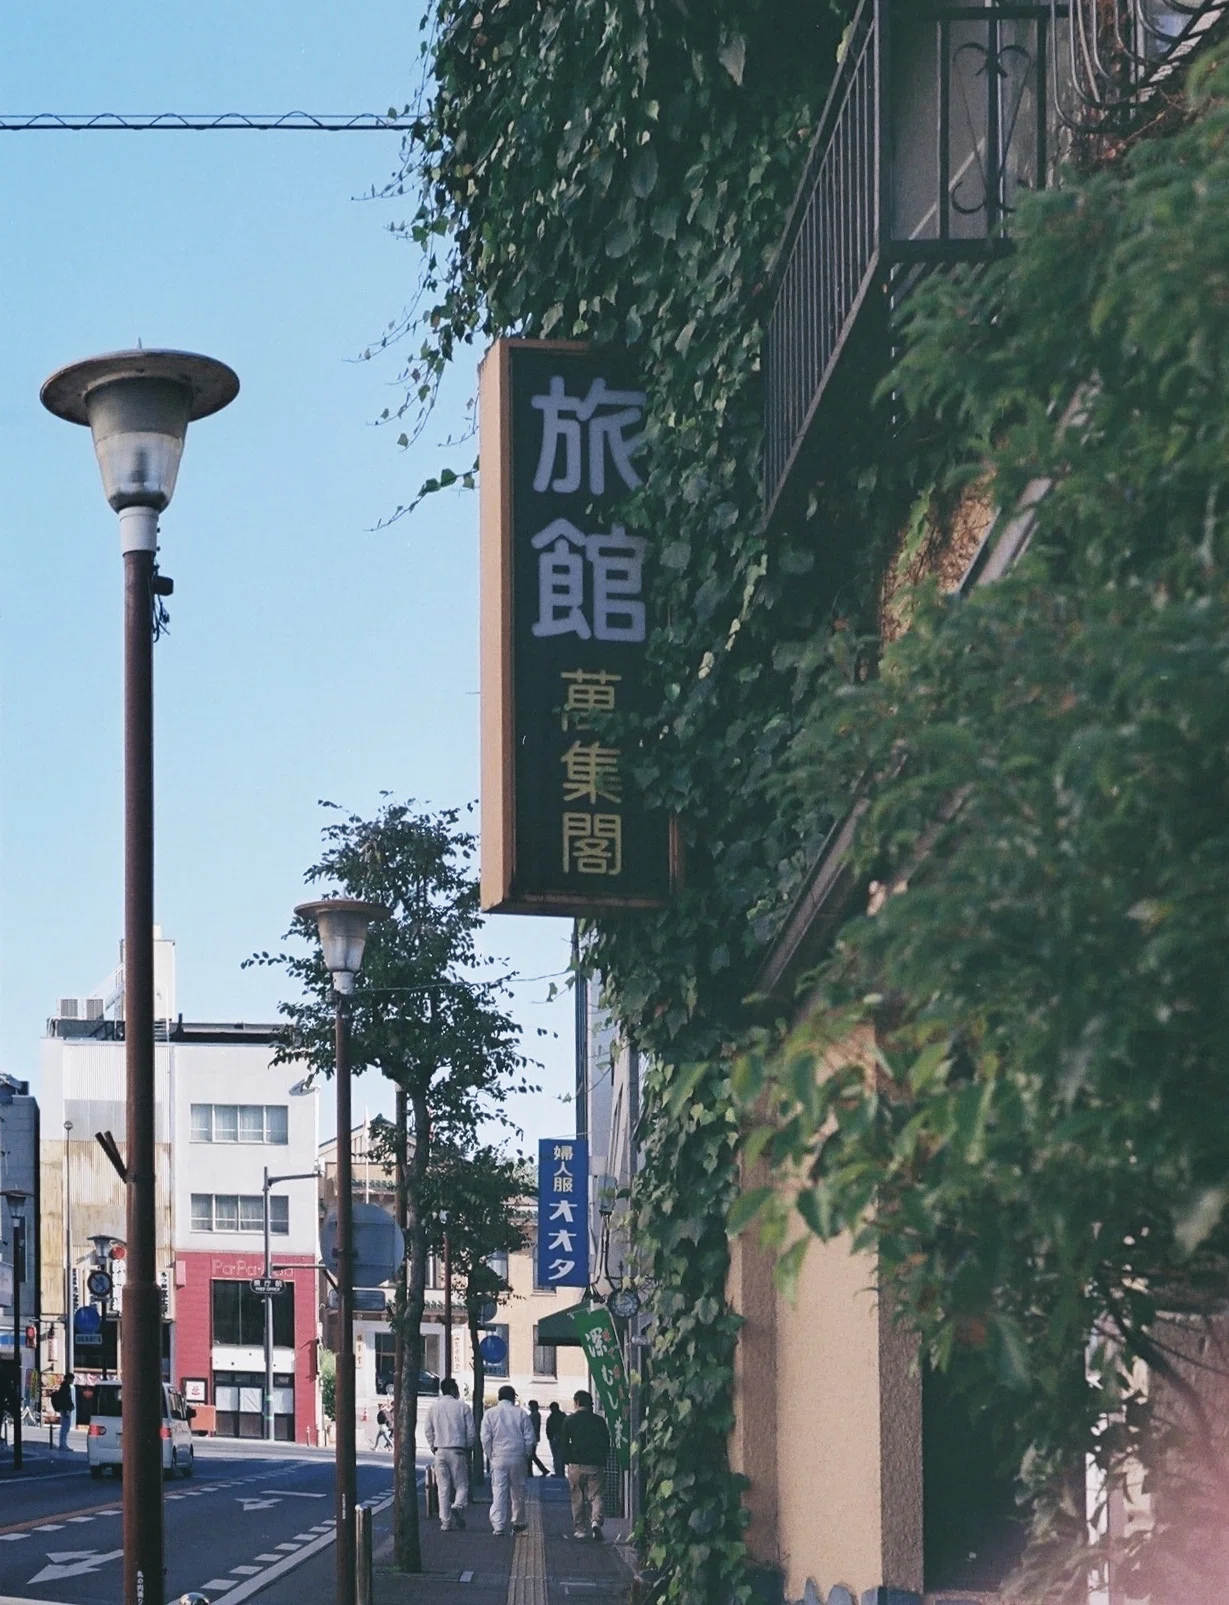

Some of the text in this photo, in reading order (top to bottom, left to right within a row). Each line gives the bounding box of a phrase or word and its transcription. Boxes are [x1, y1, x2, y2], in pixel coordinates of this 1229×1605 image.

[531, 375, 647, 642] 旅館
[548, 1145, 578, 1280] 婦人服 オオタ
